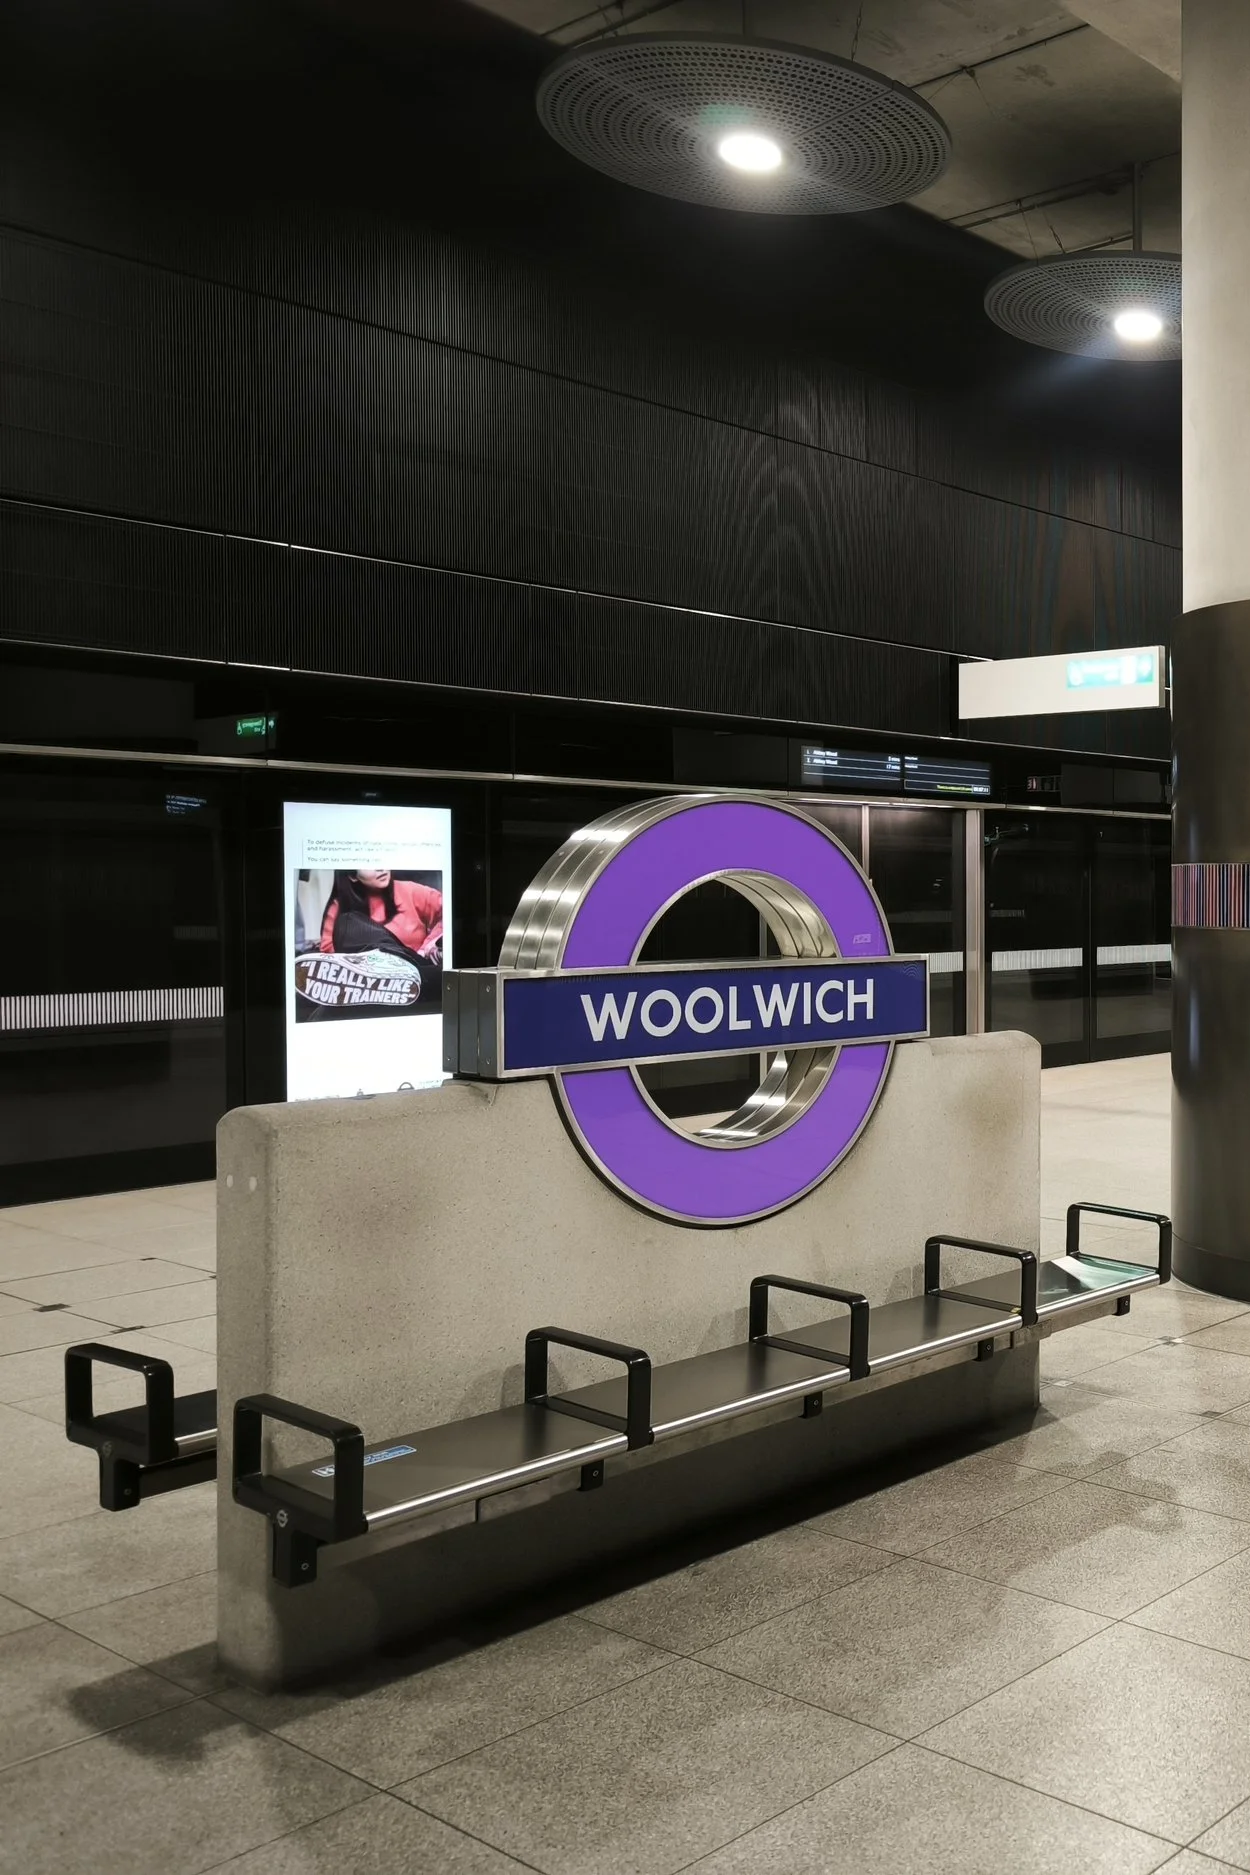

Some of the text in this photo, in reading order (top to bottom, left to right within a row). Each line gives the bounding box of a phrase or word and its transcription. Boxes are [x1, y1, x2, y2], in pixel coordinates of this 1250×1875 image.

[304, 978, 341, 1005] YOUR
[316, 961, 378, 990] REALLY
[377, 978, 413, 993] LIKE
[580, 978, 874, 1042] WOOLWICH
